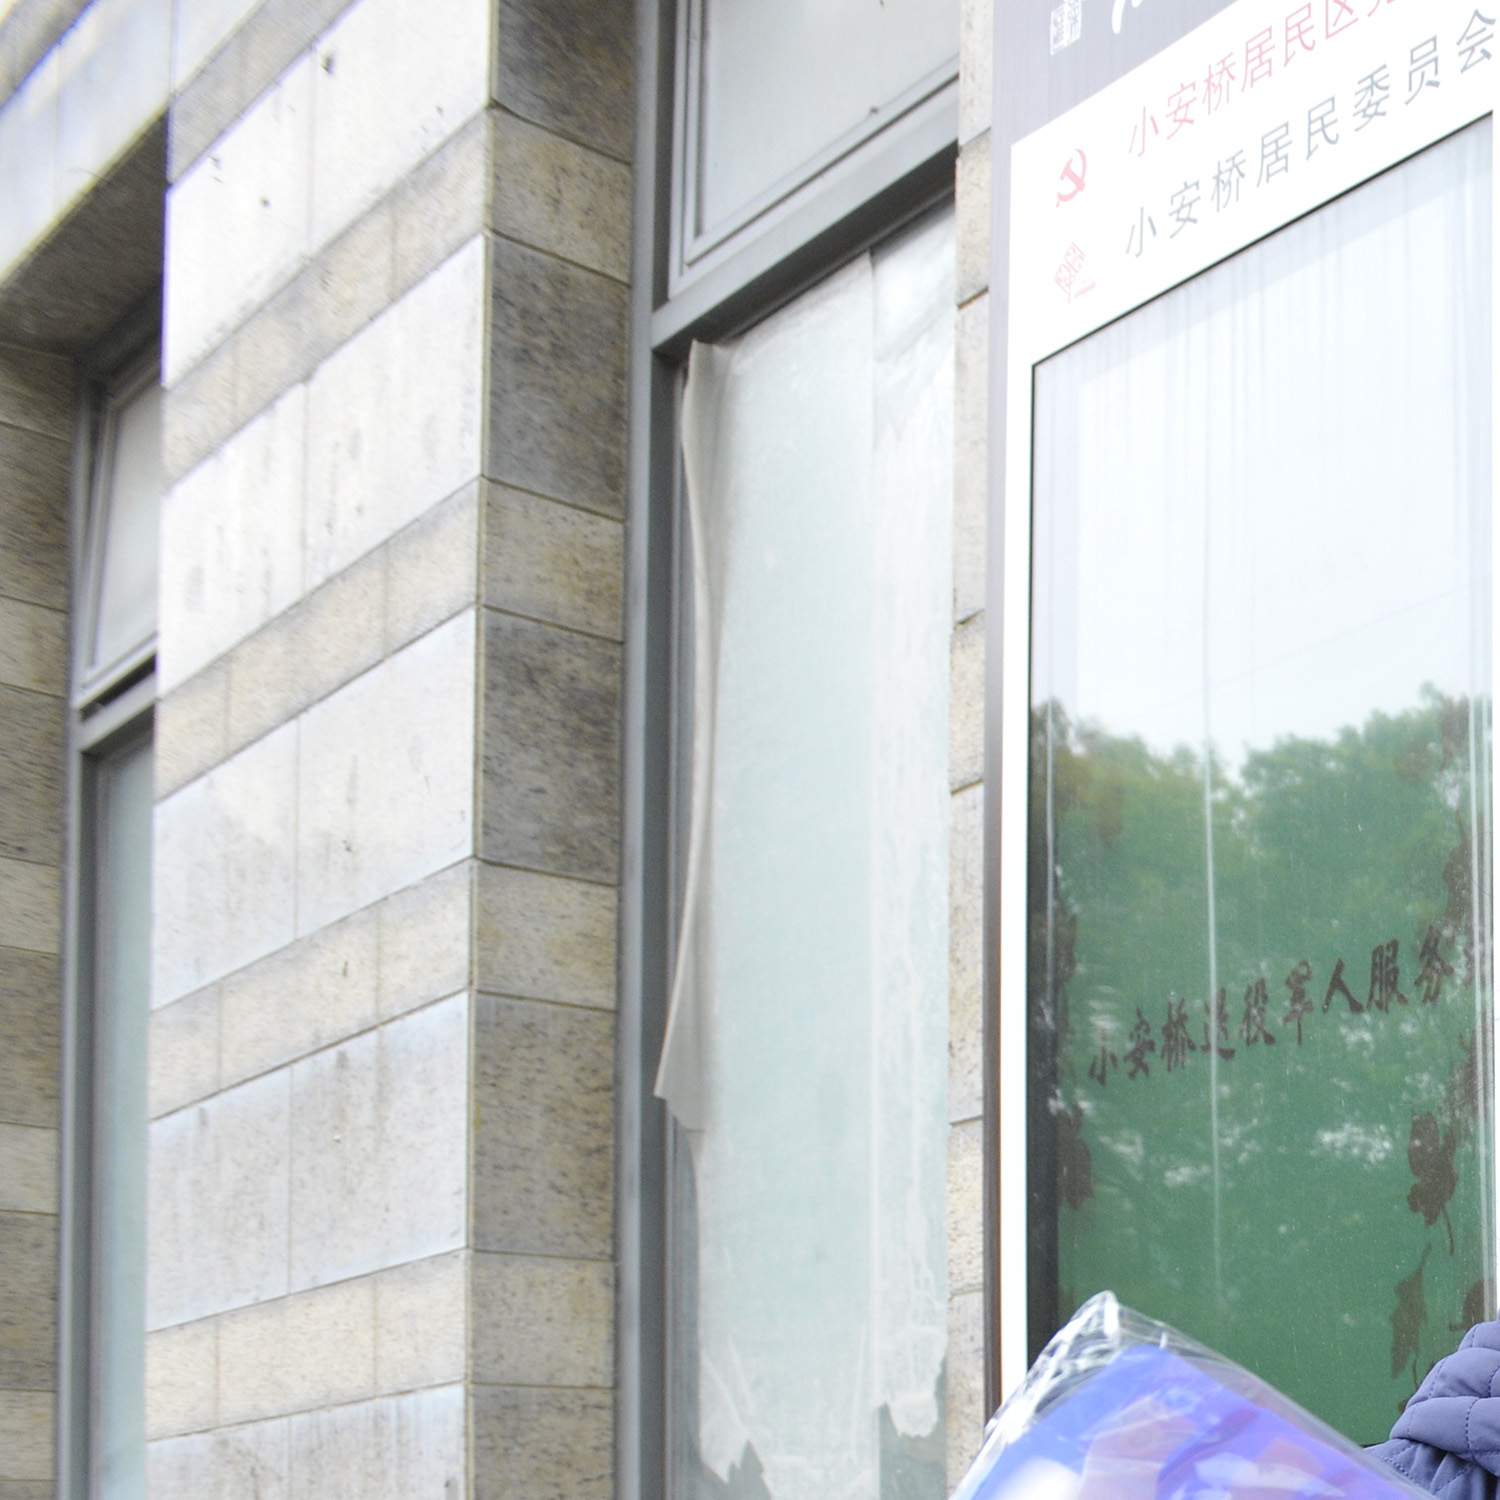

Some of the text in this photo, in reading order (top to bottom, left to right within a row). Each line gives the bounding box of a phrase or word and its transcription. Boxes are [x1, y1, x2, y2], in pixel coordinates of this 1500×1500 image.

[1125, 8, 1498, 259] 小安桥居民委员会
